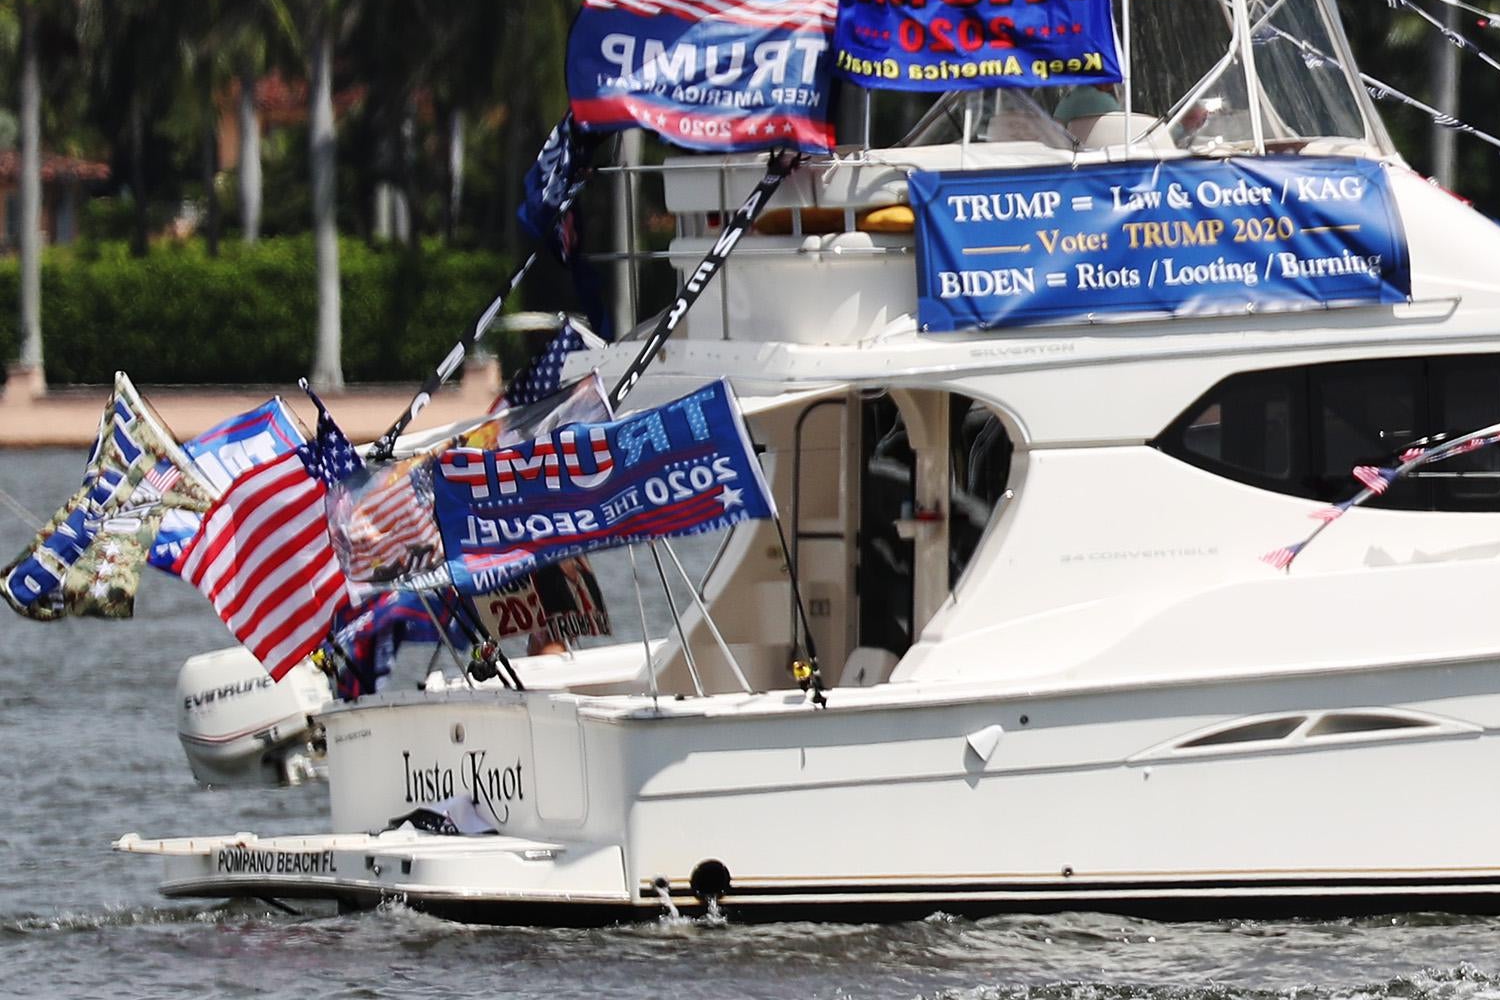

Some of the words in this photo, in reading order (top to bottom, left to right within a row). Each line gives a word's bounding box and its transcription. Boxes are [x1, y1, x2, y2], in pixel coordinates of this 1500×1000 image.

[948, 191, 1061, 223] TRUMP
[1111, 184, 1161, 211] Law
[1166, 183, 1189, 210] &
[1197, 178, 1272, 208] Order
[1298, 176, 1363, 201] KAG
[1036, 228, 1109, 256] Vote:
[1122, 221, 1224, 249] TRUMP
[1233, 216, 1295, 243] 2020
[938, 267, 1036, 299] BIDEN
[1077, 262, 1140, 291] Riots
[1162, 257, 1258, 288] Looting
[1281, 249, 1382, 279] Burning
[402, 750, 455, 804] Insta
[461, 751, 525, 824] Knot
[217, 850, 275, 874] POMPANO
[276, 850, 321, 873] BEACH
[321, 850, 338, 873] FL
